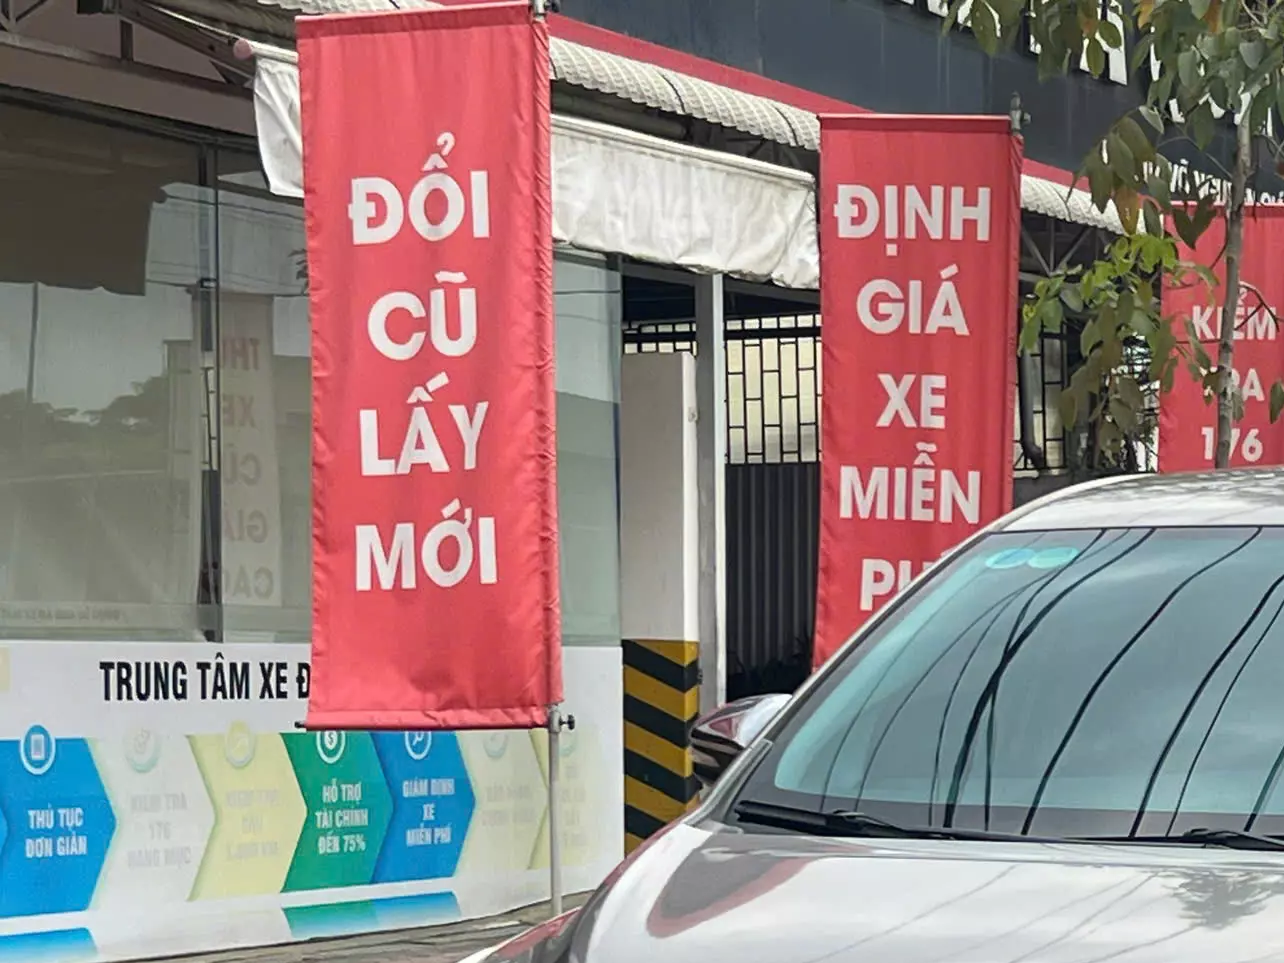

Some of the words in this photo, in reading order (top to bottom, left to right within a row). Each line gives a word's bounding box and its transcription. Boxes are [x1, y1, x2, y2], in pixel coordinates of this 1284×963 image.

[348, 131, 490, 246] ĐỔI
[834, 183, 992, 257] ĐỊNH
[367, 270, 478, 362] CŨ
[856, 264, 969, 337] GIÁ
[359, 371, 489, 477] LẤY
[876, 373, 947, 430] XE
[840, 440, 980, 525] MIỄN
[355, 497, 498, 592] MỚI
[99, 661, 188, 700] TRUNG
[196, 652, 250, 700] TÂM
[259, 661, 289, 699] XE
[343, 833, 367, 854] 75%
